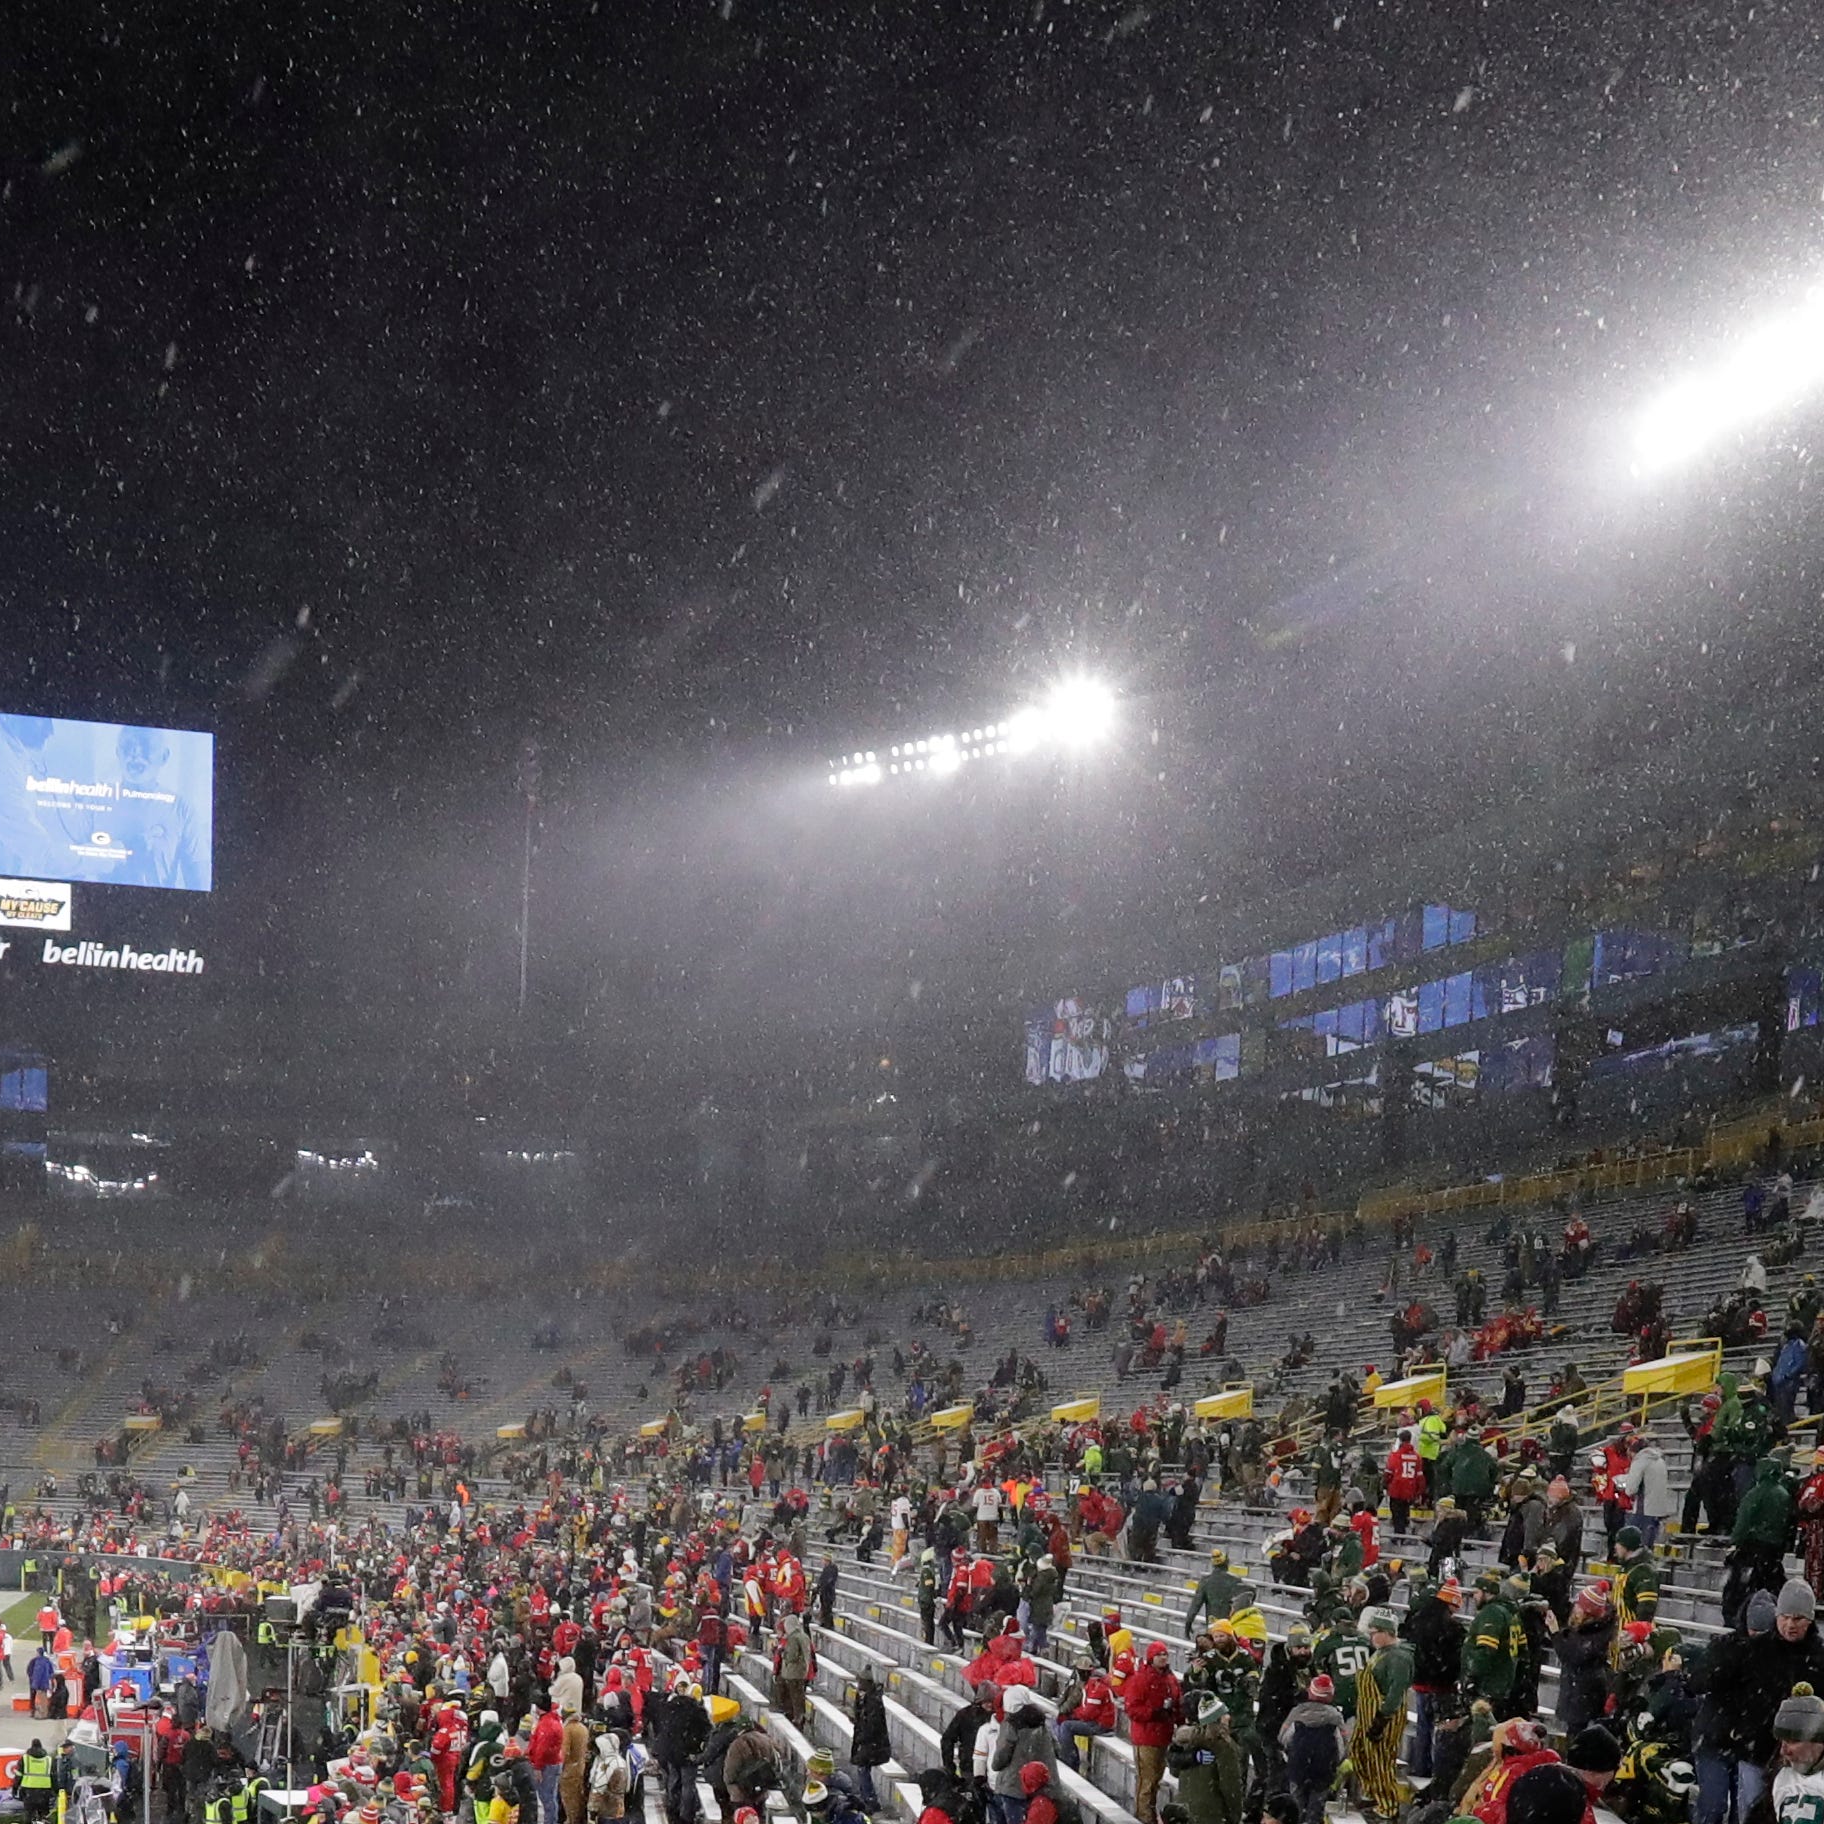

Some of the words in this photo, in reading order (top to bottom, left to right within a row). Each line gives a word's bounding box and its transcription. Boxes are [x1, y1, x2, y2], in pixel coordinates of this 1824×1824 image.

[19, 900, 59, 915] CAUSE
[43, 939, 205, 974] bellinhealth
[1402, 1461, 1417, 1479] 15
[1336, 1646, 1369, 1677] 50
